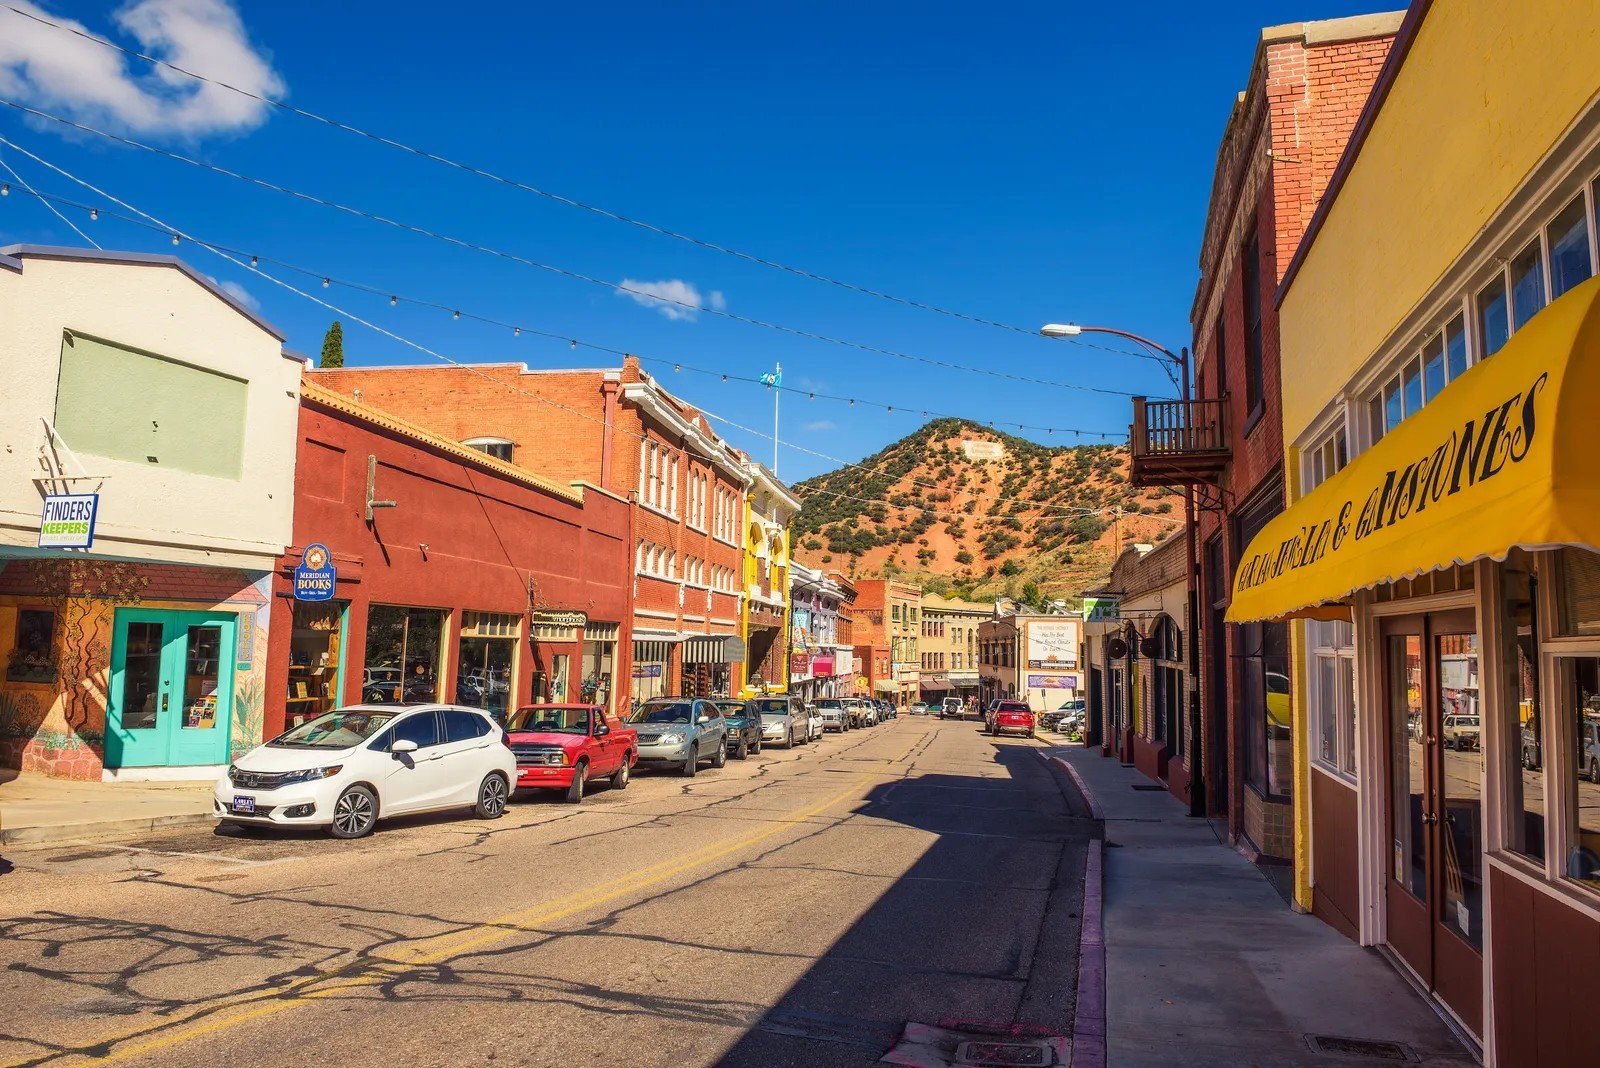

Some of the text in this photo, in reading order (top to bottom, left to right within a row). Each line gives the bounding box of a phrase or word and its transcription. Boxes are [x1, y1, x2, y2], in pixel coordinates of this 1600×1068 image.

[44, 500, 92, 521] FINDERS
[42, 522, 89, 534] KEEPERS
[1332, 500, 1352, 551] &
[297, 579, 332, 590] BOOKS
